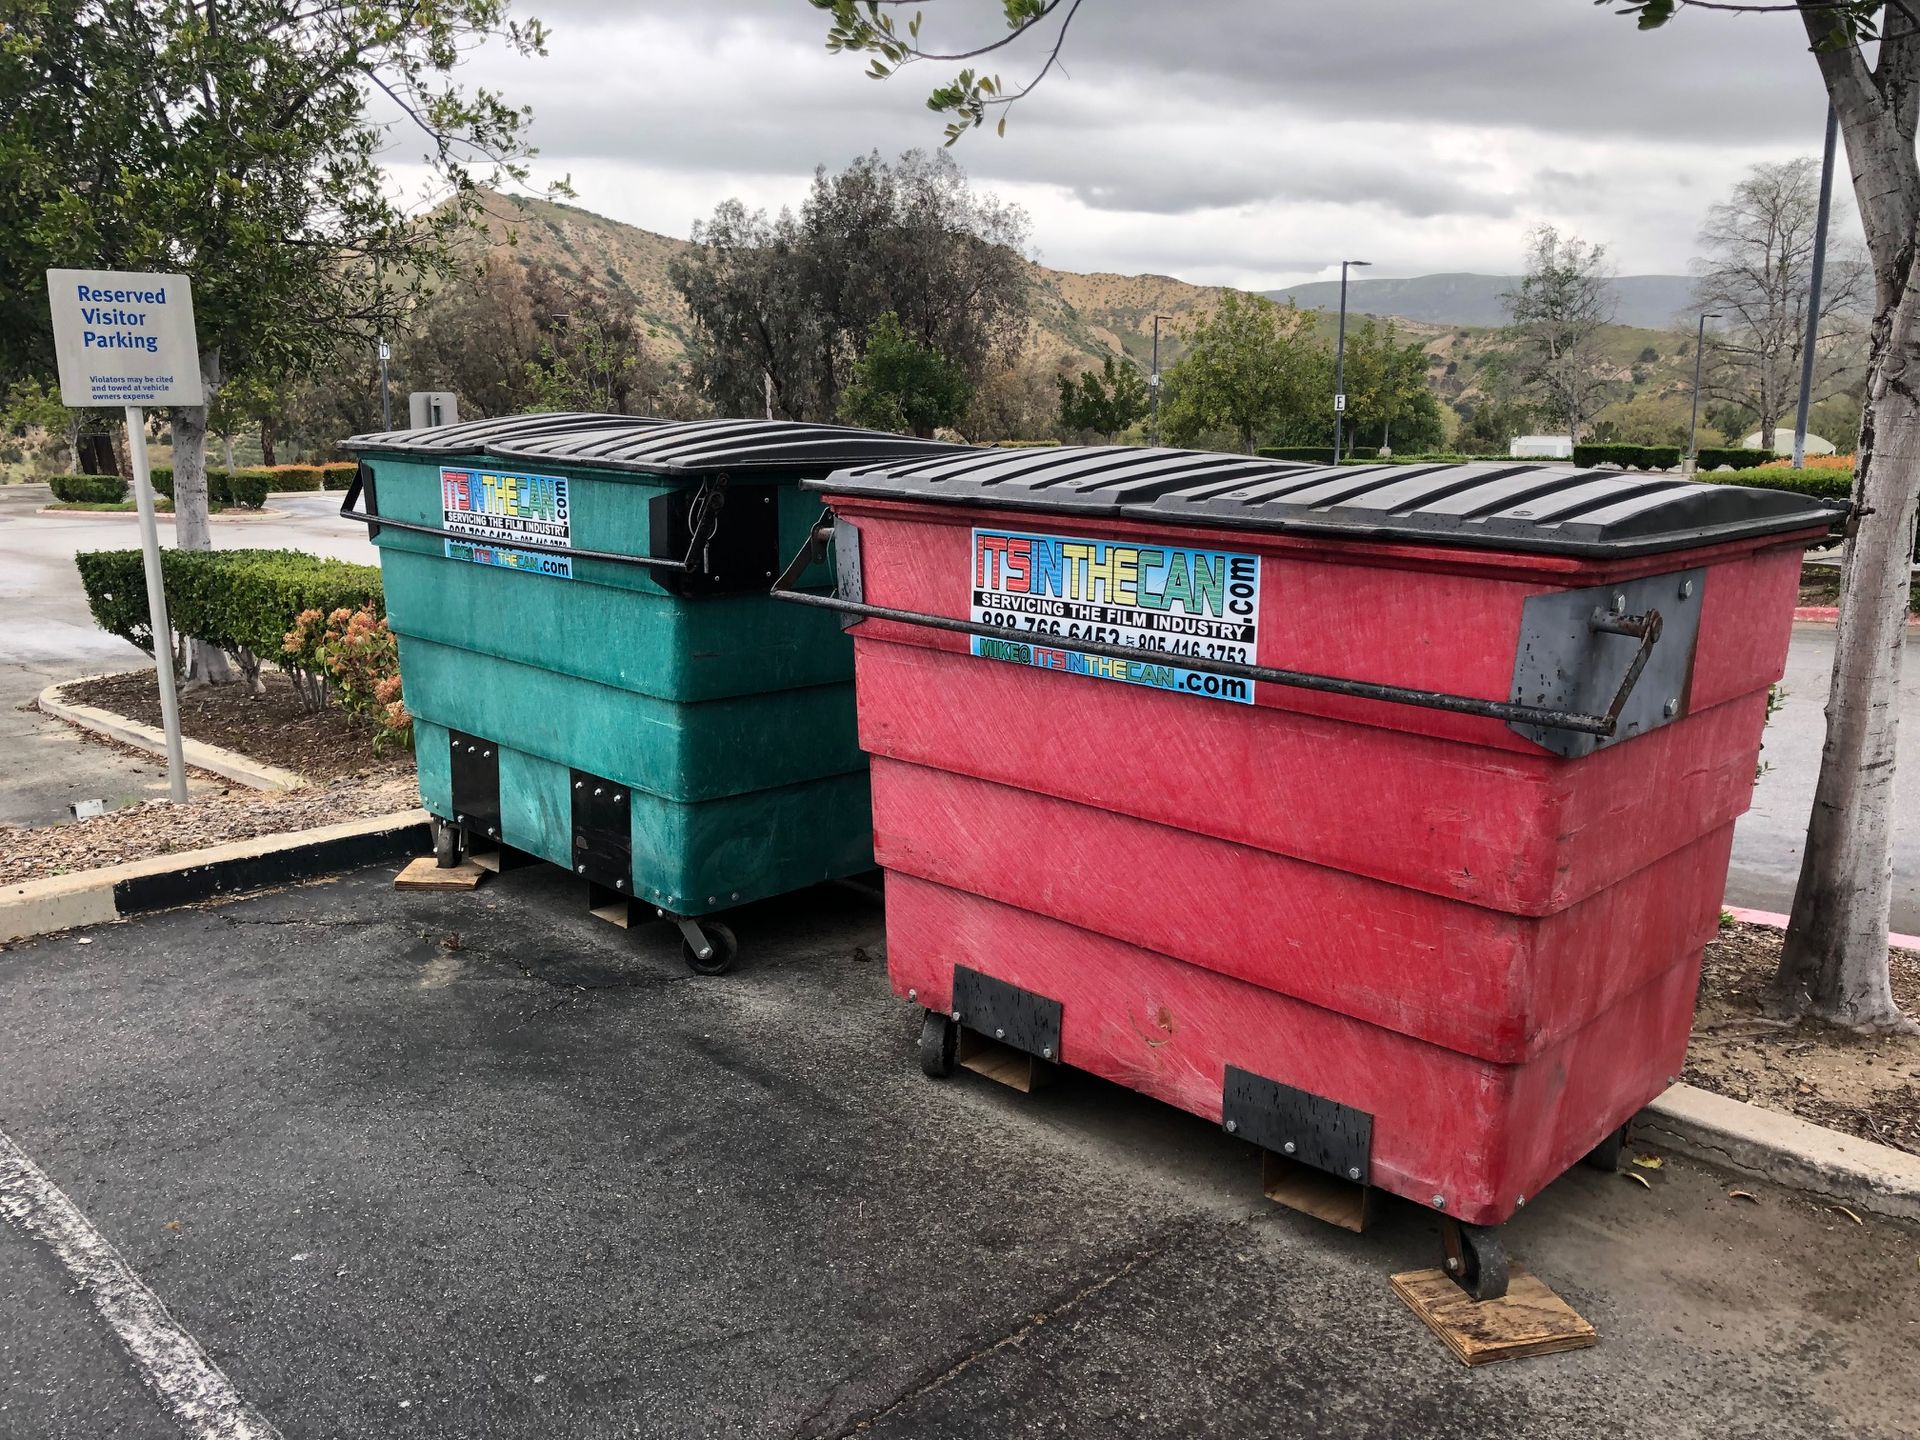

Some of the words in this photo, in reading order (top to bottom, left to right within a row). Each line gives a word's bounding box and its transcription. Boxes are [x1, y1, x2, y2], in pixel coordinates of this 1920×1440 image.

[77, 285, 167, 305] Reserved
[81, 307, 147, 326] Visitor
[83, 331, 158, 353] Parking
[89, 375, 126, 383] Violators
[127, 377, 143, 385] may
[144, 375, 154, 383] be
[155, 375, 174, 383] cited
[108, 384, 132, 392] towed
[142, 384, 170, 392] vehicle
[122, 393, 155, 401] expense
[1336, 396, 1344, 409] E
[442, 471, 556, 523] ITSINTHECAN
[555, 481, 568, 526] .com
[448, 512, 487, 526] SERVICING
[488, 515, 504, 528] THE
[505, 519, 524, 531] FILM
[525, 521, 566, 537] INDUSTRY
[975, 534, 1226, 618] ITSINTHECAN
[1229, 557, 1255, 624] .com
[981, 593, 1064, 616] SERVICING
[1069, 604, 1101, 621] THE
[1106, 609, 1147, 628] FILM
[1153, 614, 1247, 640] INDUSTRY
